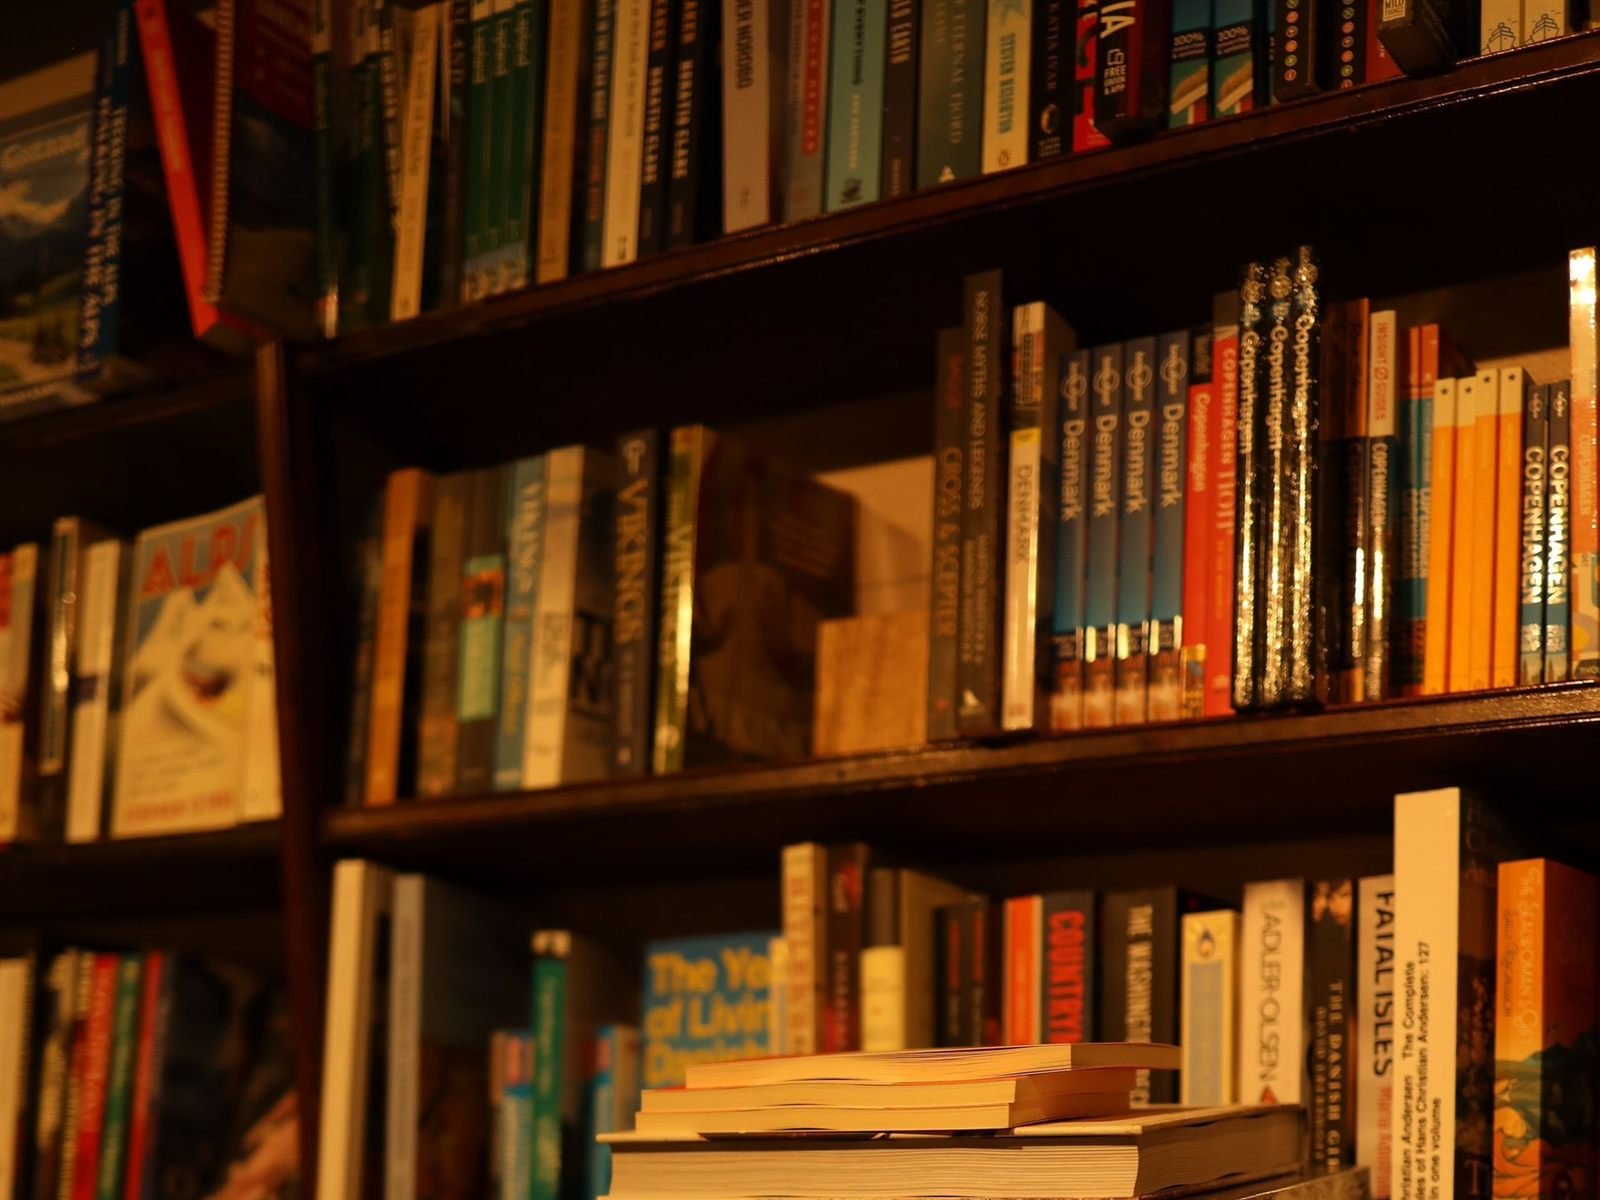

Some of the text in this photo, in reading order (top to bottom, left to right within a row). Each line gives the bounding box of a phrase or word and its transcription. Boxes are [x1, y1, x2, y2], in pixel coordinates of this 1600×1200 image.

[967, 290, 989, 511] NORSE MYTHS AND LEGENDS
[1218, 347, 1238, 465] COPENHAGEN
[1238, 330, 1261, 455] Copenhagen
[1265, 324, 1289, 450] Copenhagen
[1061, 418, 1086, 523] Denmark
[1093, 413, 1119, 518] Denmark
[1125, 409, 1151, 514] Denmark
[1160, 403, 1186, 508] Denmark
[1188, 392, 1212, 493] Copenhagen
[615, 479, 649, 645] VIKINGS
[1013, 464, 1034, 565] DENMARK
[1521, 446, 1545, 605] COPENHAGEN
[1546, 444, 1570, 605] COPENHAGEN
[1258, 911, 1283, 1082] ADLER-OLSEN
[1402, 960, 1417, 1029] Complete
[1417, 939, 1430, 964] 127
[688, 994, 772, 1039] Livin
[1402, 1032, 1414, 1059] The
[1416, 968, 1430, 1043] Andersen:
[1325, 979, 1345, 1174] THE DANISH GIR
[1400, 1074, 1414, 1143] Andersen
[1414, 1047, 1428, 1112] Christian
[1429, 1097, 1442, 1151] volume
[1414, 1116, 1428, 1153] Hans
[1414, 1156, 1427, 1172] of
[1430, 1154, 1441, 1182] one
[1428, 1186, 1440, 1200] in
